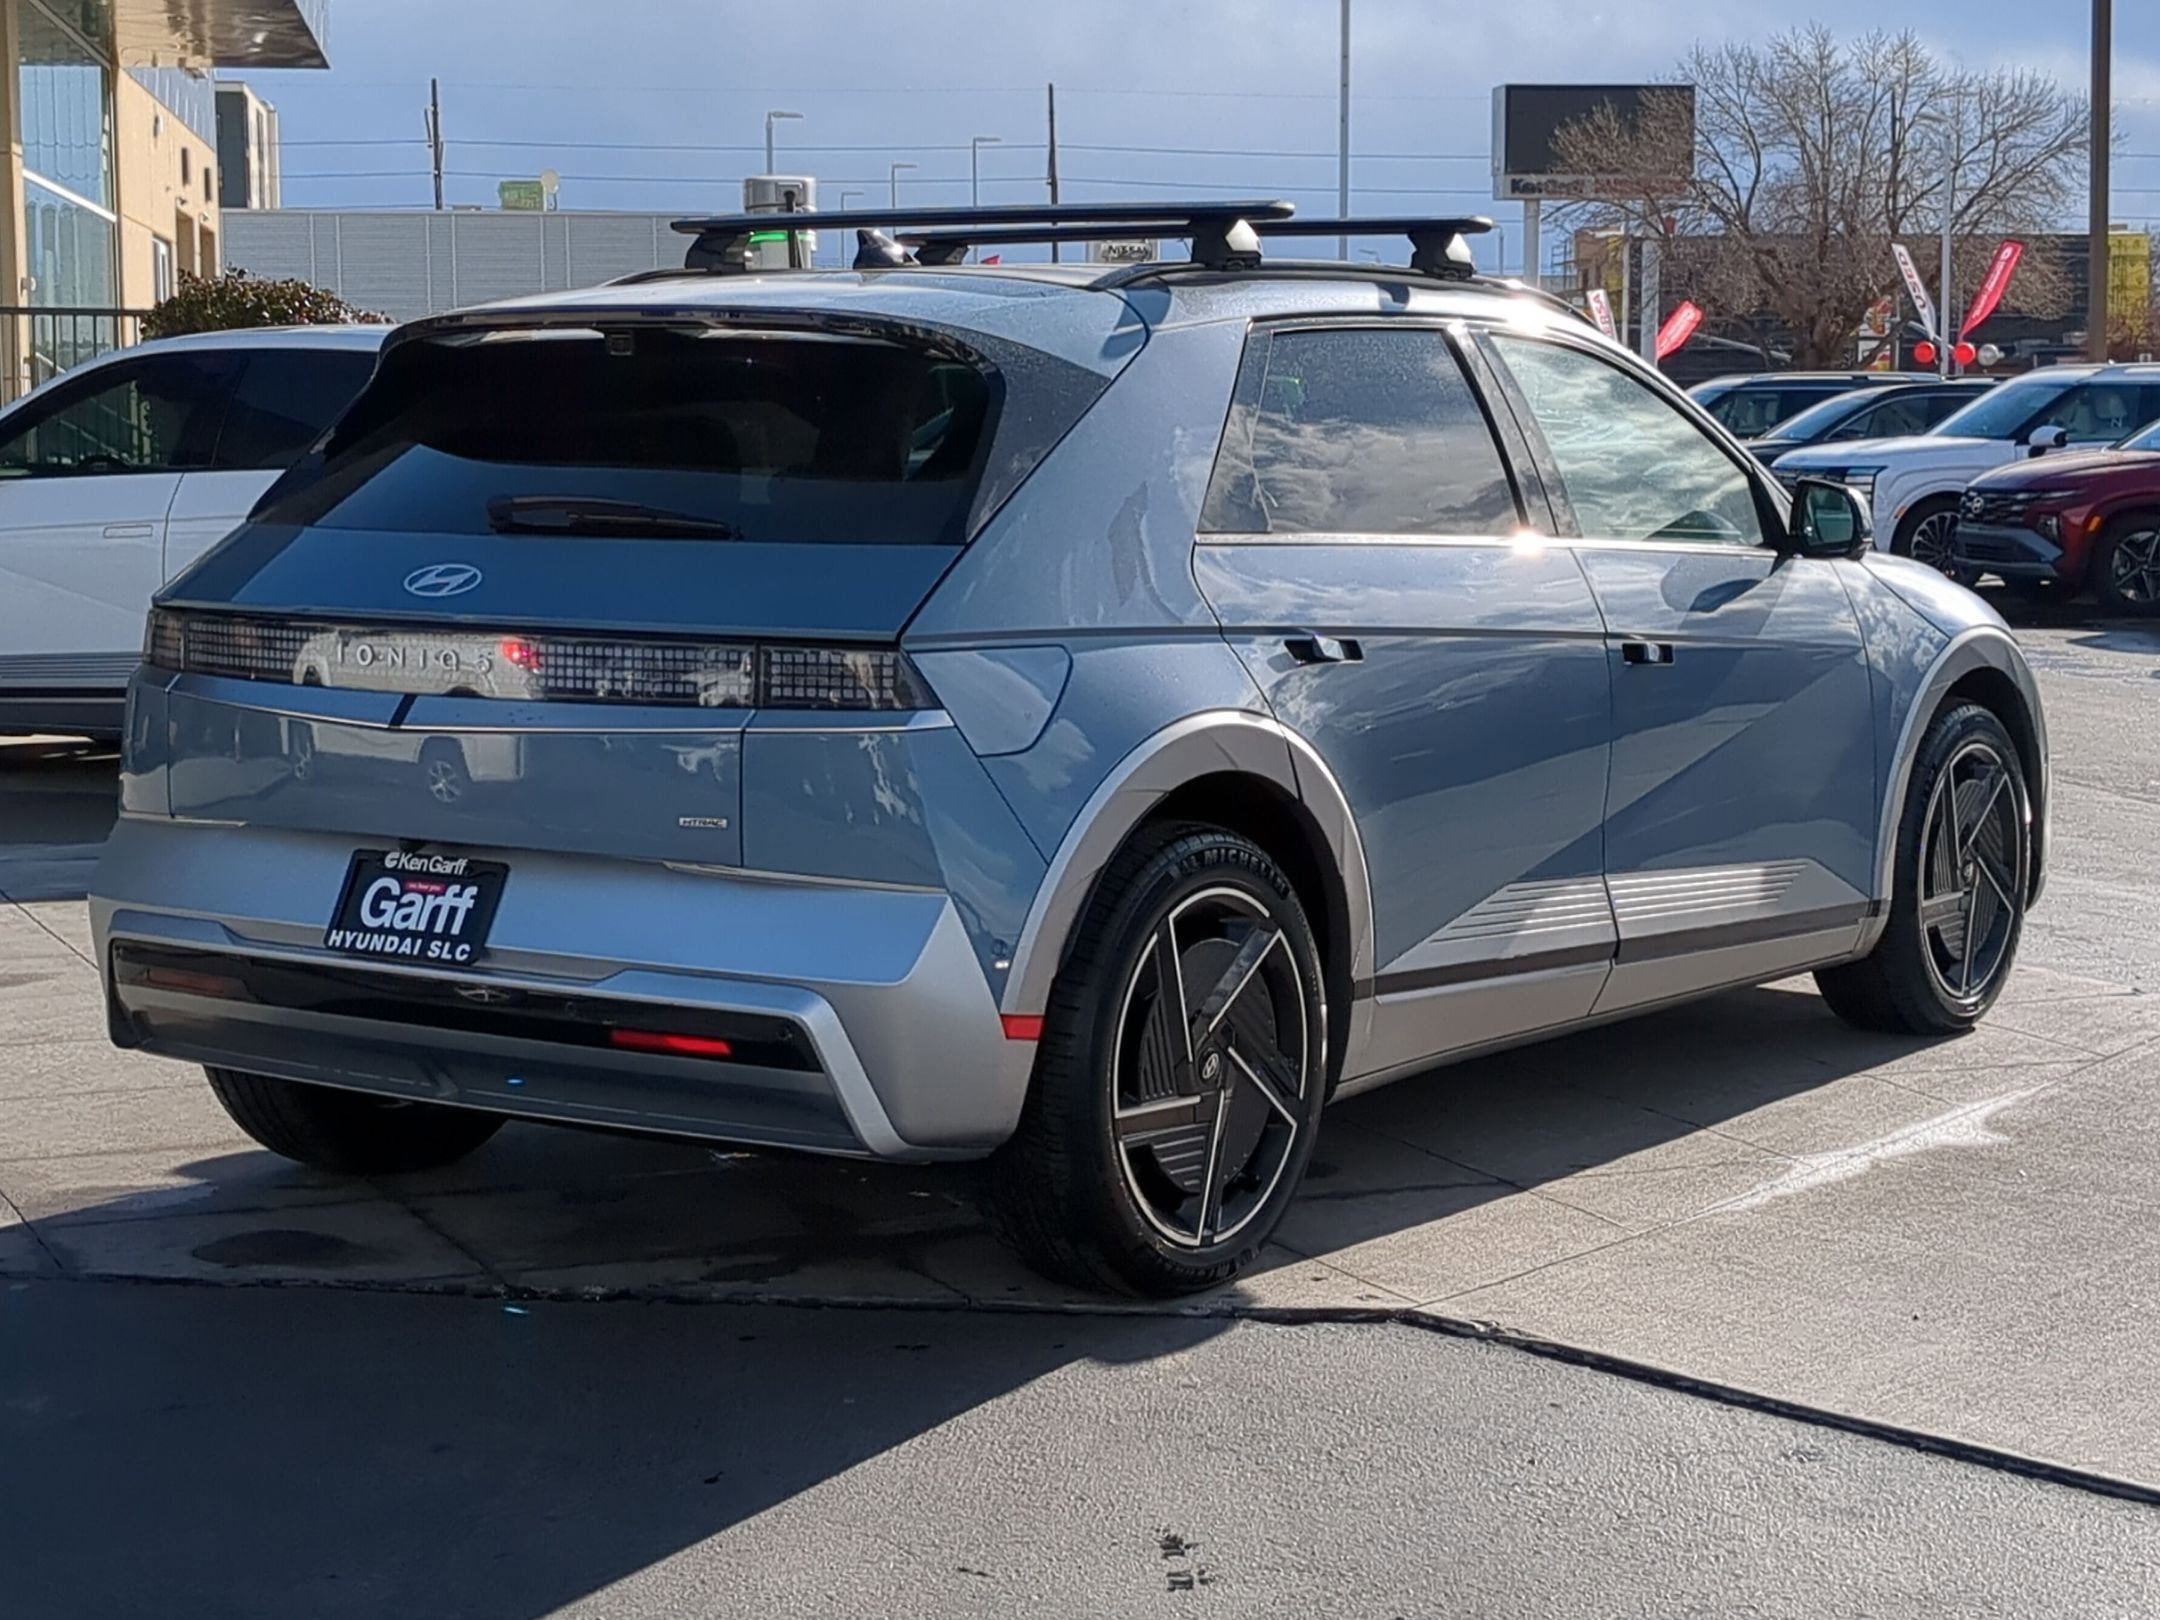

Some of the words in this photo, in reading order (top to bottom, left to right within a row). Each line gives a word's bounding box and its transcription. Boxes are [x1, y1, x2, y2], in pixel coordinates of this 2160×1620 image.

[1898, 252, 1927, 310] USED
[337, 638, 460, 672] IONIQ
[1203, 847, 1289, 898] MICHELIN
[360, 877, 479, 936] Garff
[328, 929, 422, 956] HYUNDAI
[427, 940, 471, 962] SLC
